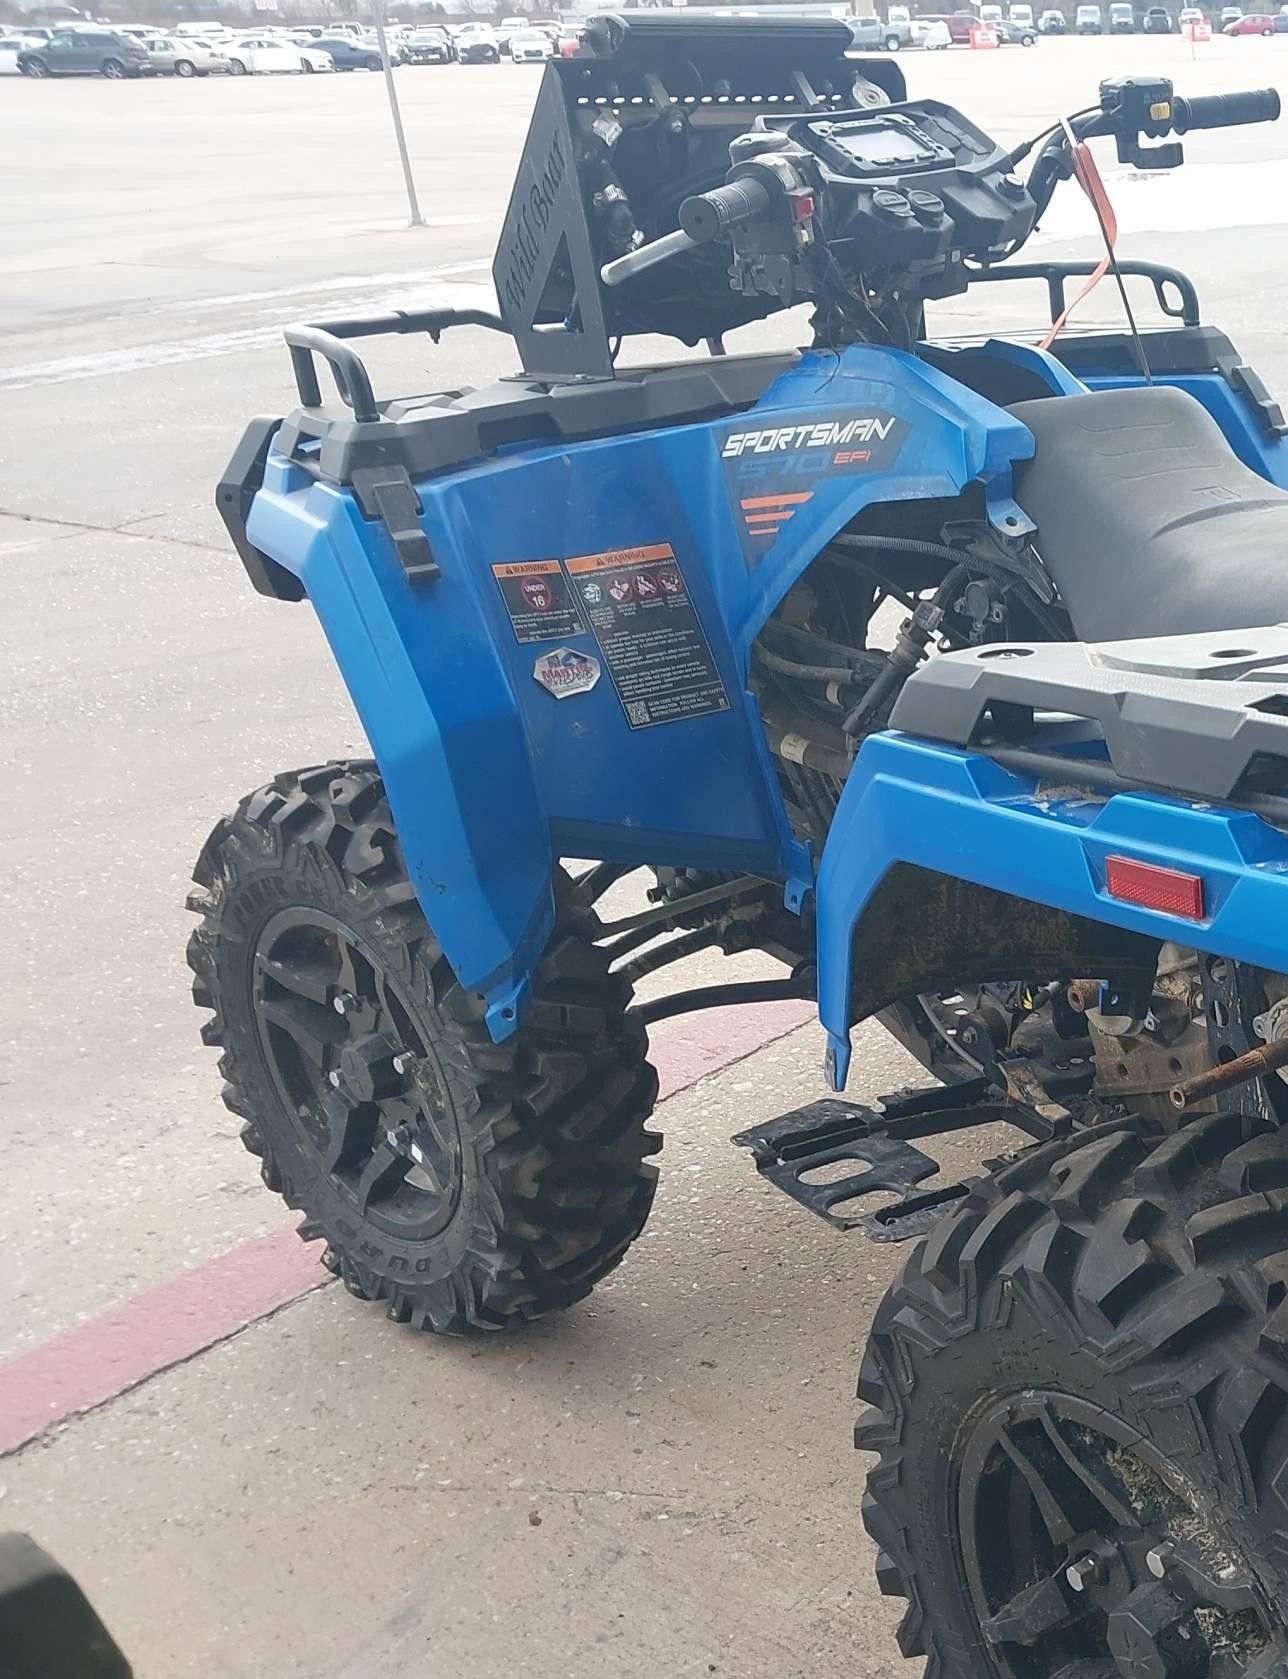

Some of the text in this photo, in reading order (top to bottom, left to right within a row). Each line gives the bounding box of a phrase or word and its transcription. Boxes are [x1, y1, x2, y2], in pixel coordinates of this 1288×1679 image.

[721, 417, 896, 458] SPORTSMAN
[737, 450, 872, 480] 570 EFI
[606, 550, 646, 564] WARNING
[513, 563, 549, 574] WARNING
[524, 583, 546, 593] UNDER
[532, 595, 546, 608] 16
